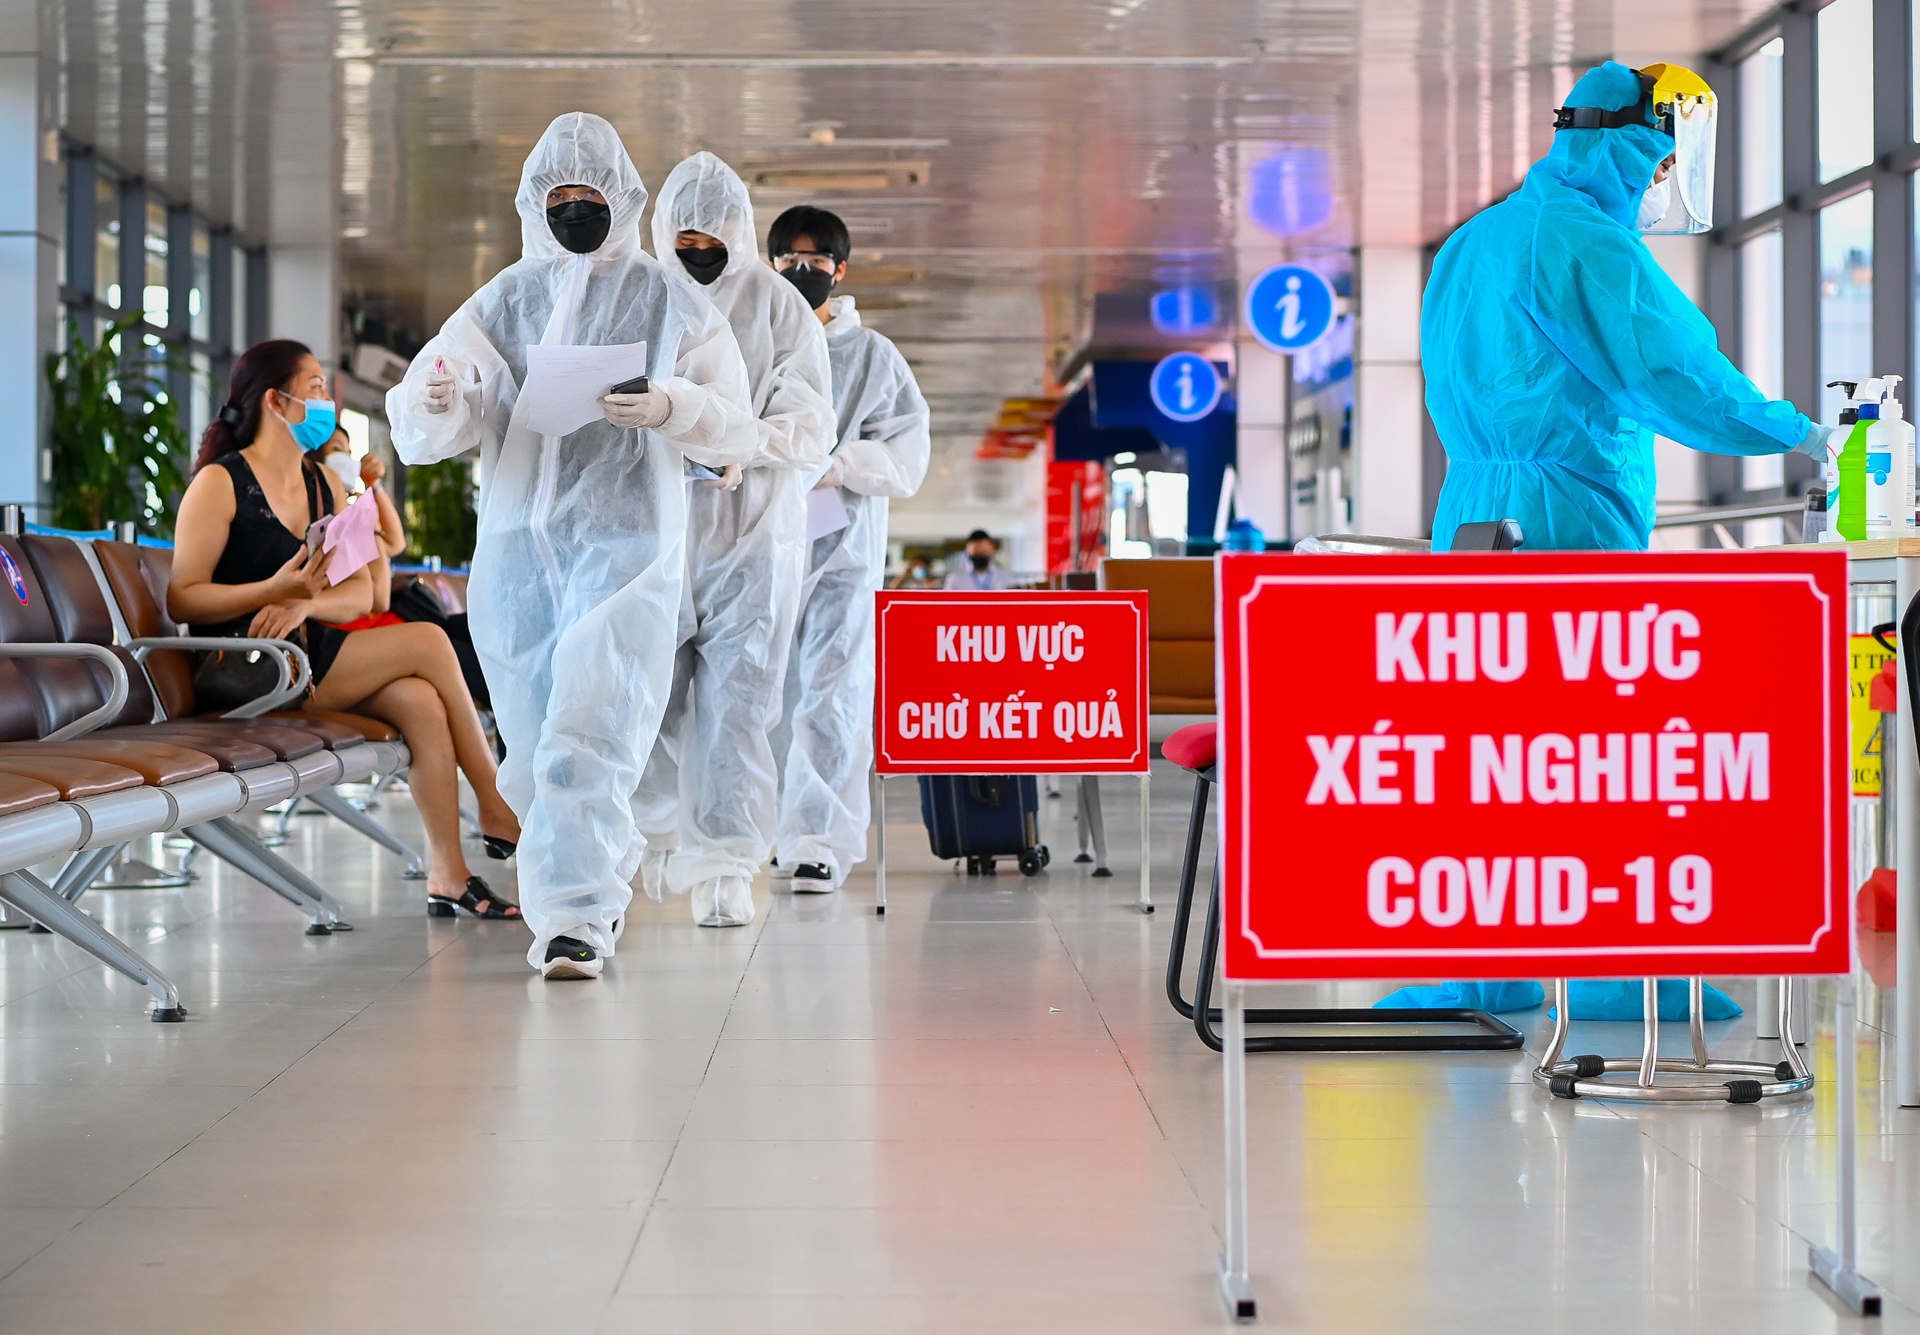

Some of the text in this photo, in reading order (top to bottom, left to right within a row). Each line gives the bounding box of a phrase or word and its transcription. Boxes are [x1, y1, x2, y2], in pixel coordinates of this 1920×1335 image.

[936, 621, 1084, 671] KHU VỰC
[1376, 603, 1700, 696] KHU VỰC
[898, 688, 1124, 743] CHỜ KẾT QUẢ
[1306, 717, 1770, 817] XÉT NGHIỆM
[1367, 855, 1712, 927] COVID-19
